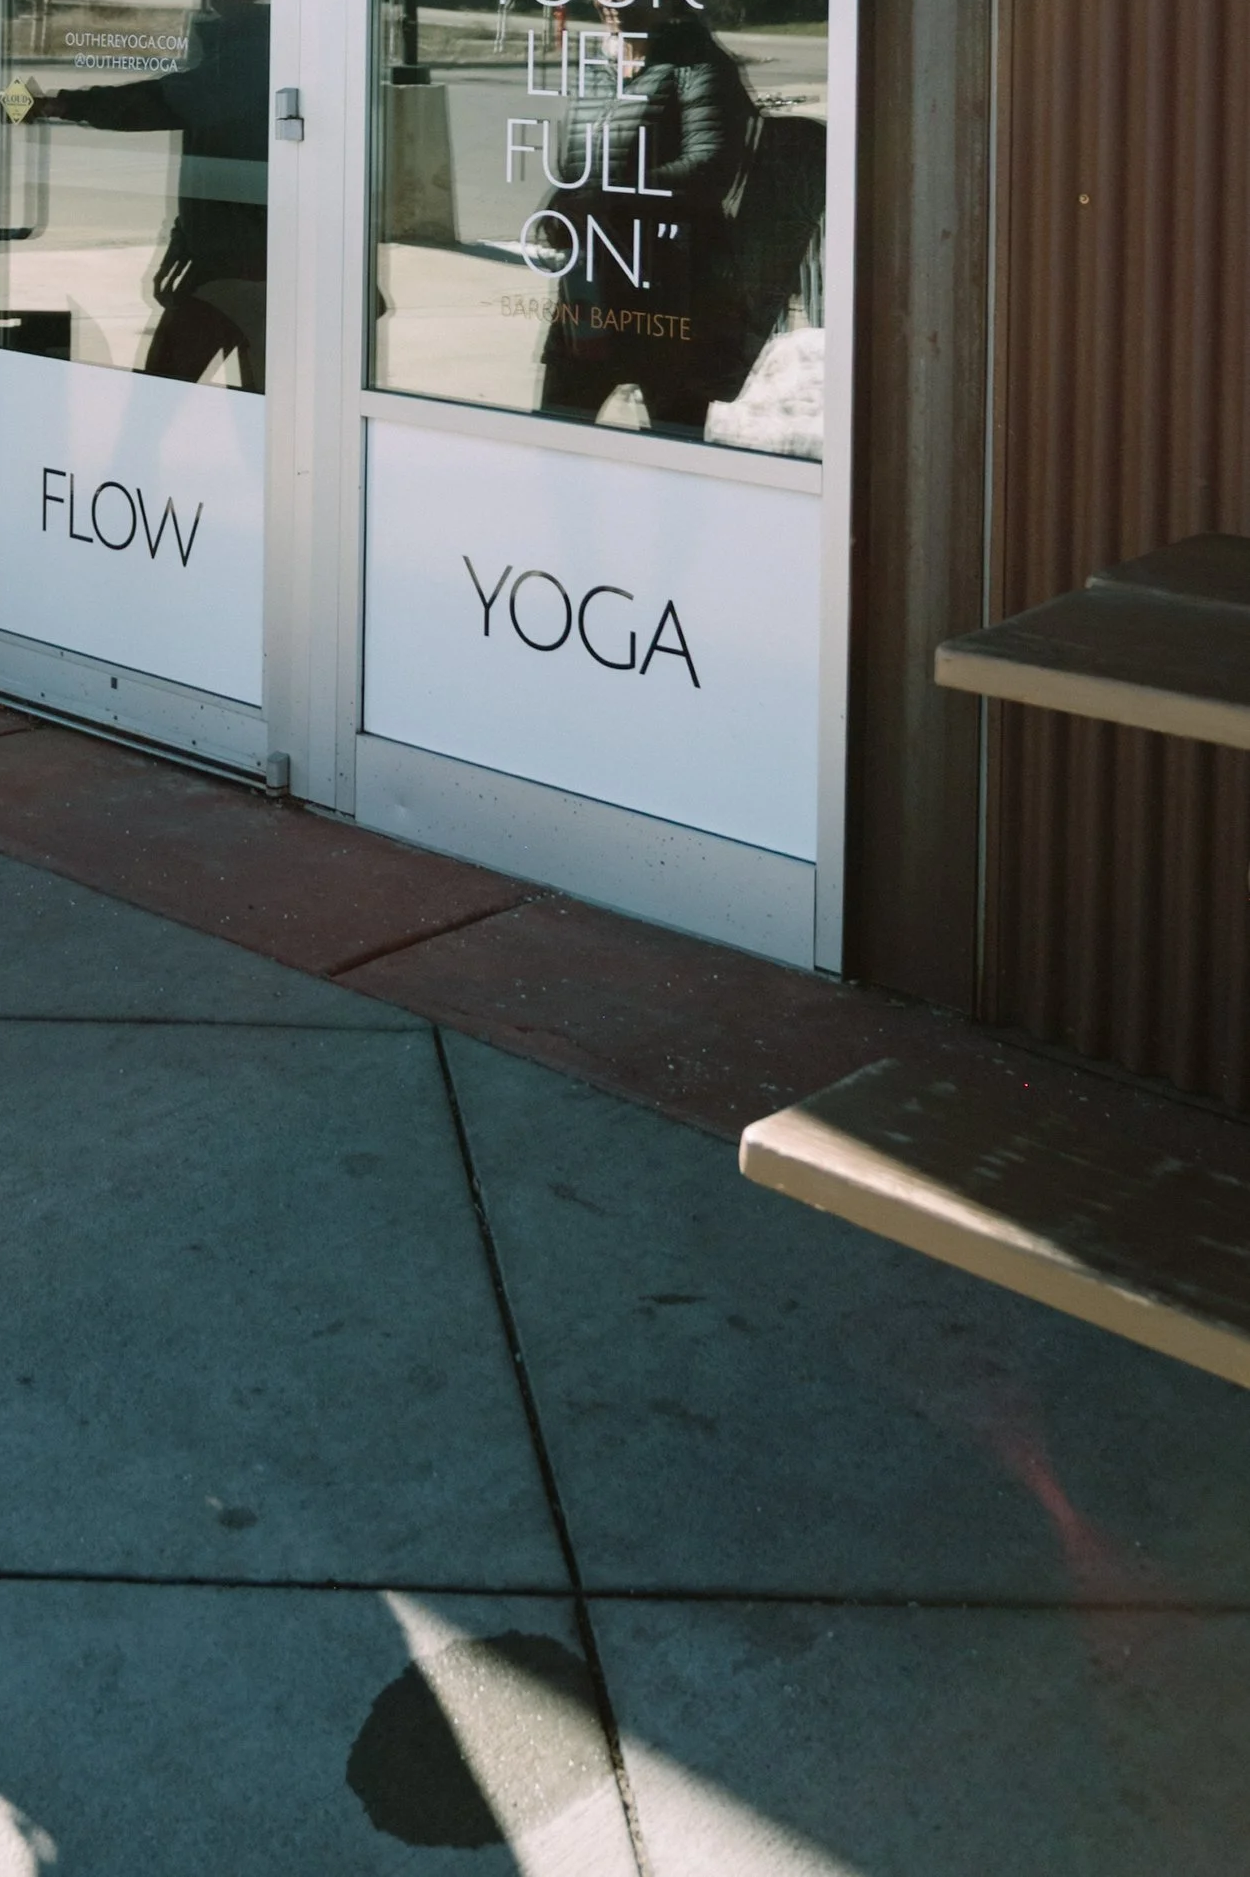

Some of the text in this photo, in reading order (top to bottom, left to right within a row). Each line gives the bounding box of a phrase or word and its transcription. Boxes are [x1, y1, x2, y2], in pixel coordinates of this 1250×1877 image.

[65, 31, 188, 50] OUTHEREYOGA.COM
[74, 52, 179, 72] @OUTHEREYOGA
[527, 29, 649, 101] LIFE
[506, 118, 672, 197] FULL
[520, 209, 678, 289] ON."
[500, 295, 691, 341] BARON BAPTISTE
[42, 467, 203, 568] FLOW
[461, 554, 701, 689] YOGA
